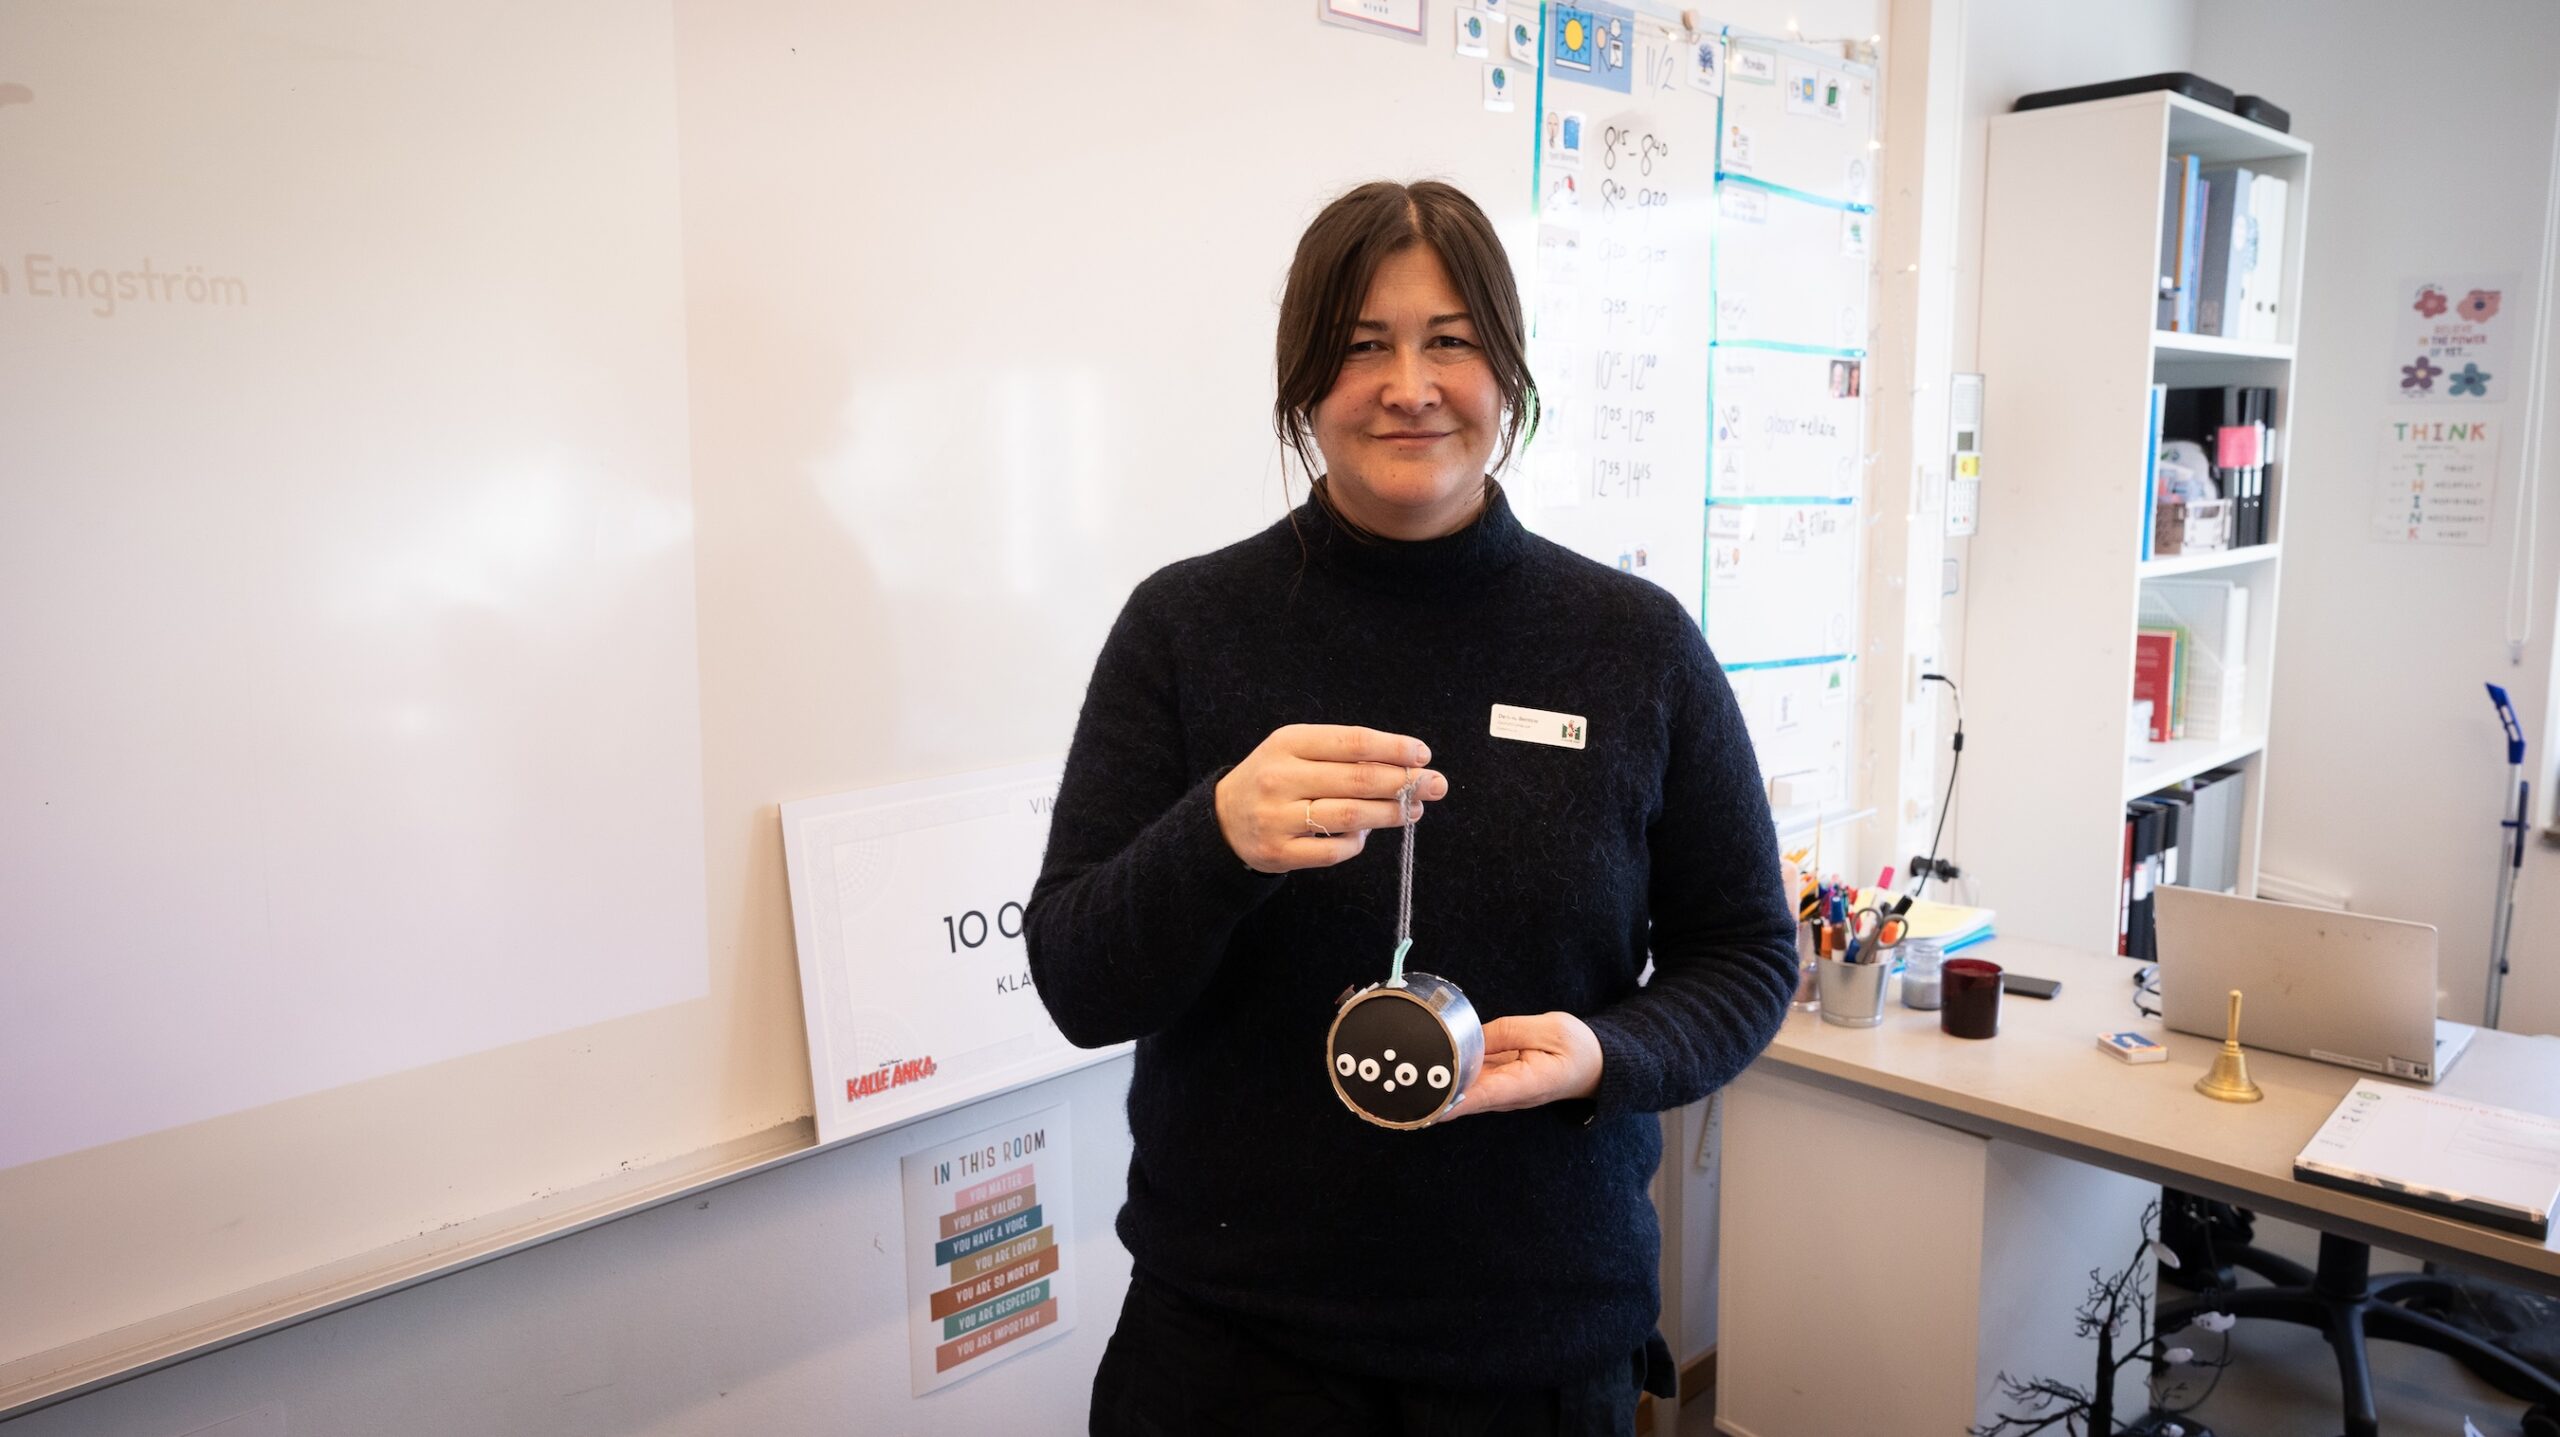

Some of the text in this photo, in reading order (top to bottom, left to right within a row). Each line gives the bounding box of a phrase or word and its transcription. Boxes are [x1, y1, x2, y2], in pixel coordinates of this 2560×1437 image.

[23, 254, 248, 318] Engström
[2393, 422, 2487, 441] THINK
[943, 910, 988, 953] 10
[846, 1055, 935, 1103] KALLE ANKA
[934, 1128, 1045, 1186] IN THIS ROOM
[969, 1172, 1024, 1203] YOU MATTER
[952, 1194, 1024, 1232] YOU ARE VALUED
[952, 1214, 1028, 1255] YOU HAVE A VOICE
[974, 1236, 1038, 1272] YOU ARE LOVED
[955, 1258, 1041, 1304] YOU ARE SO WORTHY
[958, 1286, 1041, 1332] YOU ARE RESPECTED
[956, 1310, 1041, 1358] YOU ARE IMPORTANT
